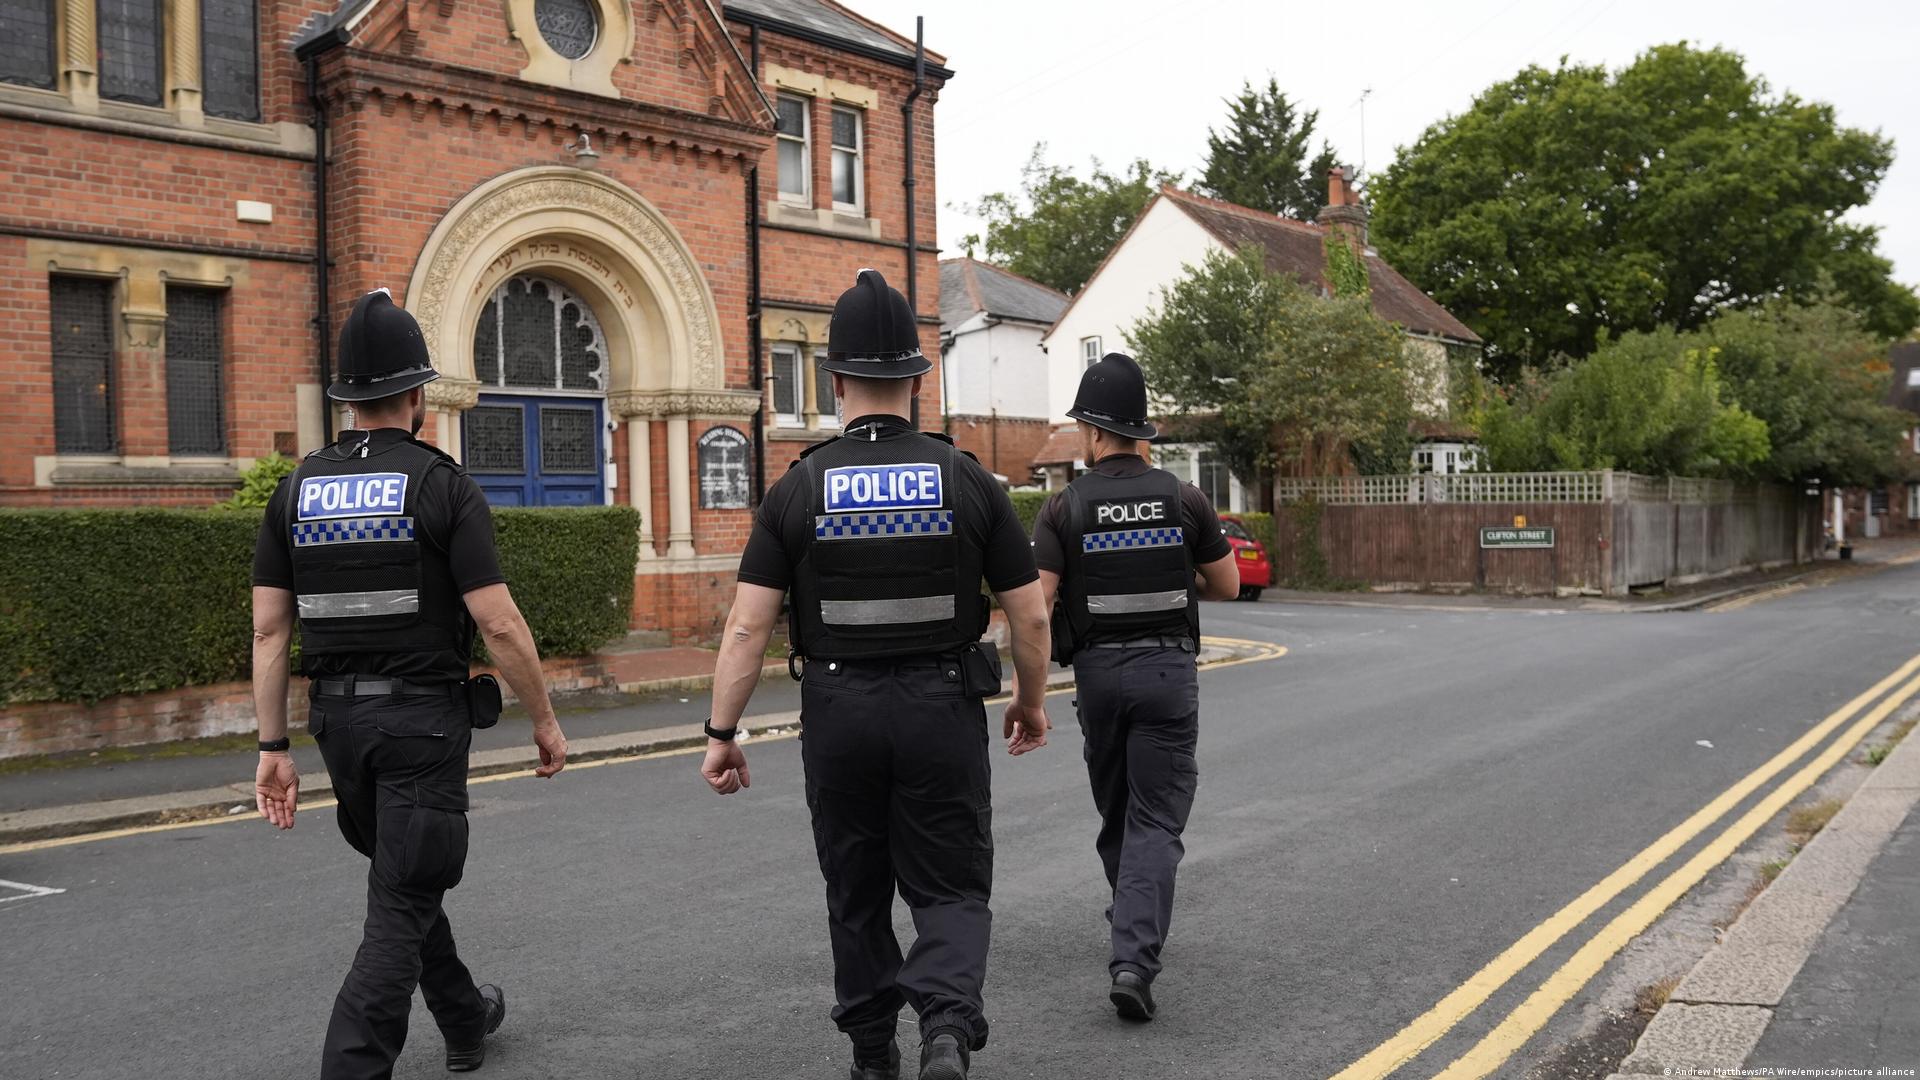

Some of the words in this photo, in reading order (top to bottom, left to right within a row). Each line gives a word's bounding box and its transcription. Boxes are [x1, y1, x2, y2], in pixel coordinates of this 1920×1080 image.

[303, 479, 400, 512] POLICE
[831, 470, 937, 504] POLICE
[1097, 501, 1164, 524] POLICE
[1486, 531, 1517, 540] CLIFTON
[1519, 530, 1546, 540] STREET
